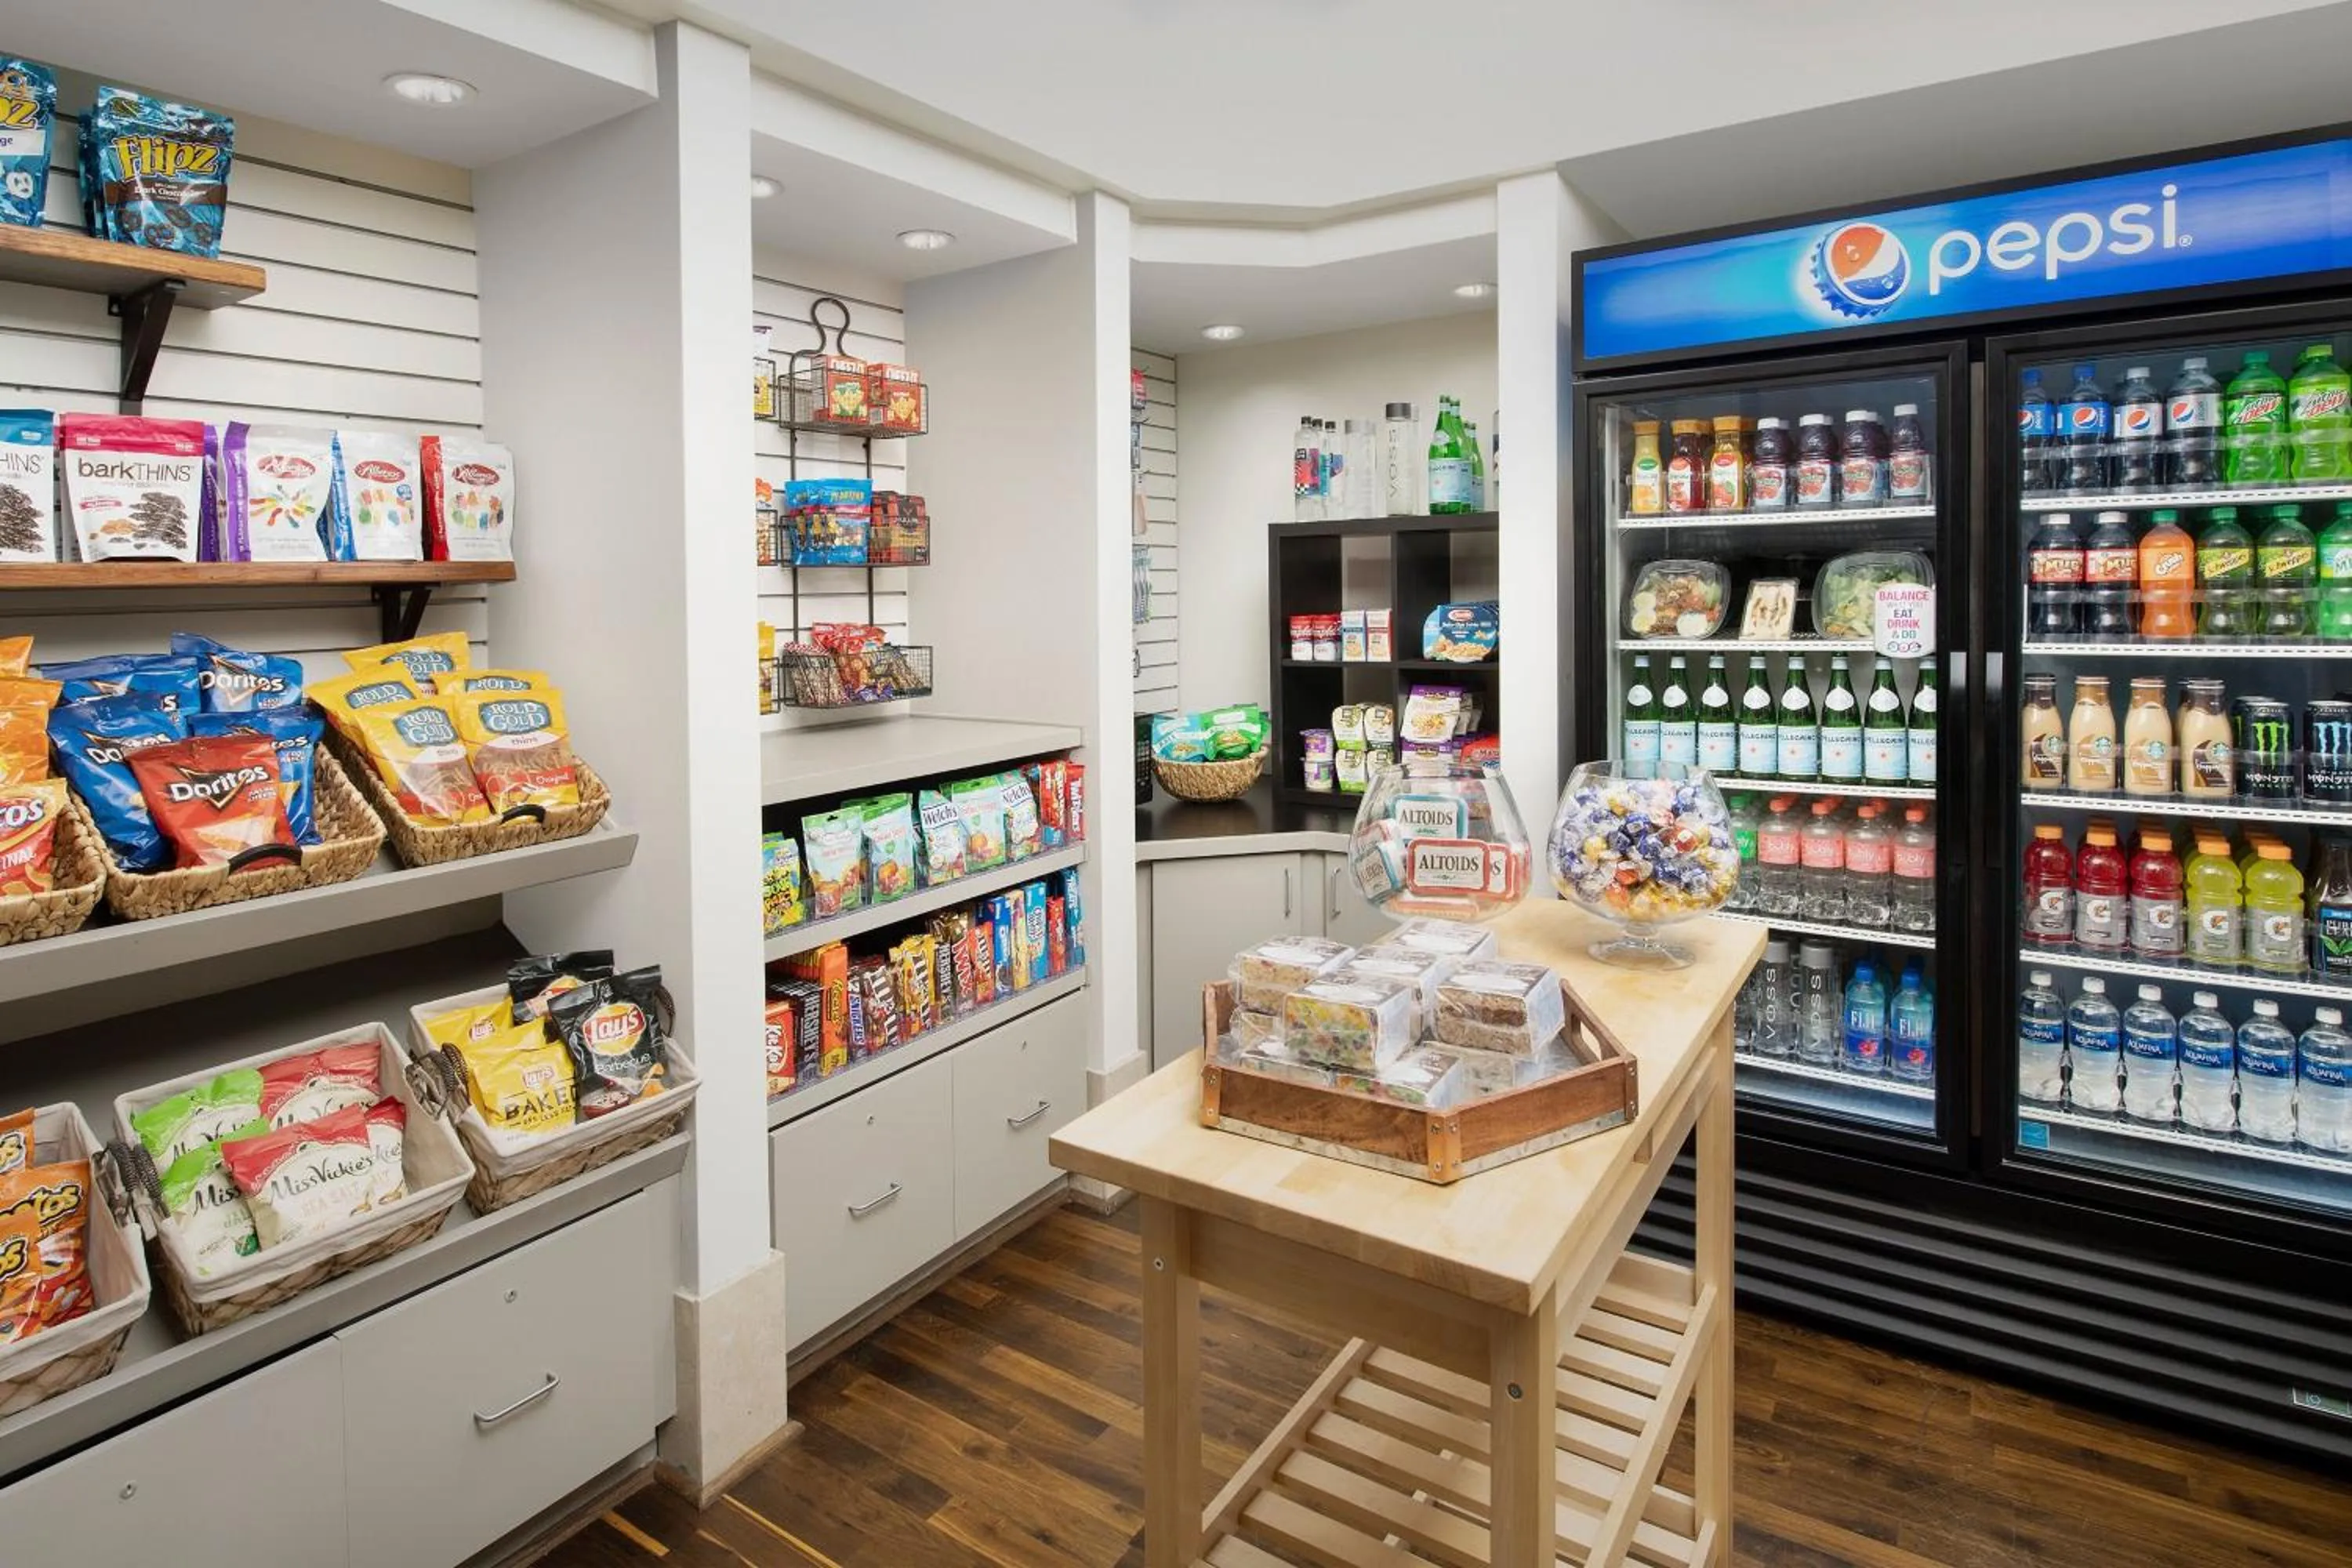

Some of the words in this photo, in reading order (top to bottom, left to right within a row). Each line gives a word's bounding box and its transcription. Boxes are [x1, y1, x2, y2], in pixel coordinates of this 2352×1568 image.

[116, 136, 220, 180] Flipz
[1929, 183, 2177, 296] pepsi
[78, 458, 191, 482] barkTHINS
[1878, 590, 1929, 601] BALANCE
[1887, 619, 1920, 628] DRINK
[1893, 609, 1912, 618] EAT
[198, 670, 285, 692] Doritos
[354, 684, 398, 705] ROLD
[405, 708, 445, 727] ROLD
[490, 701, 539, 714] ROLD
[488, 713, 546, 731] GOLD
[407, 724, 454, 744] GOLD
[169, 764, 270, 802] Doritos
[923, 804, 958, 826] Welch's
[1399, 809, 1454, 826] ALTOIDS
[1418, 855, 1480, 873] ALTOIDS
[587, 1009, 644, 1044] Lay's
[804, 993, 821, 1065] HERSHEY'S
[849, 993, 865, 1046] SNICKERS
[1850, 1011, 1875, 1029] FIJI
[2127, 1039, 2163, 1054] AQUAFINA
[270, 1174, 315, 1206] Miss
[307, 1156, 375, 1184] Vickie's
[192, 1184, 241, 1217] Miss
